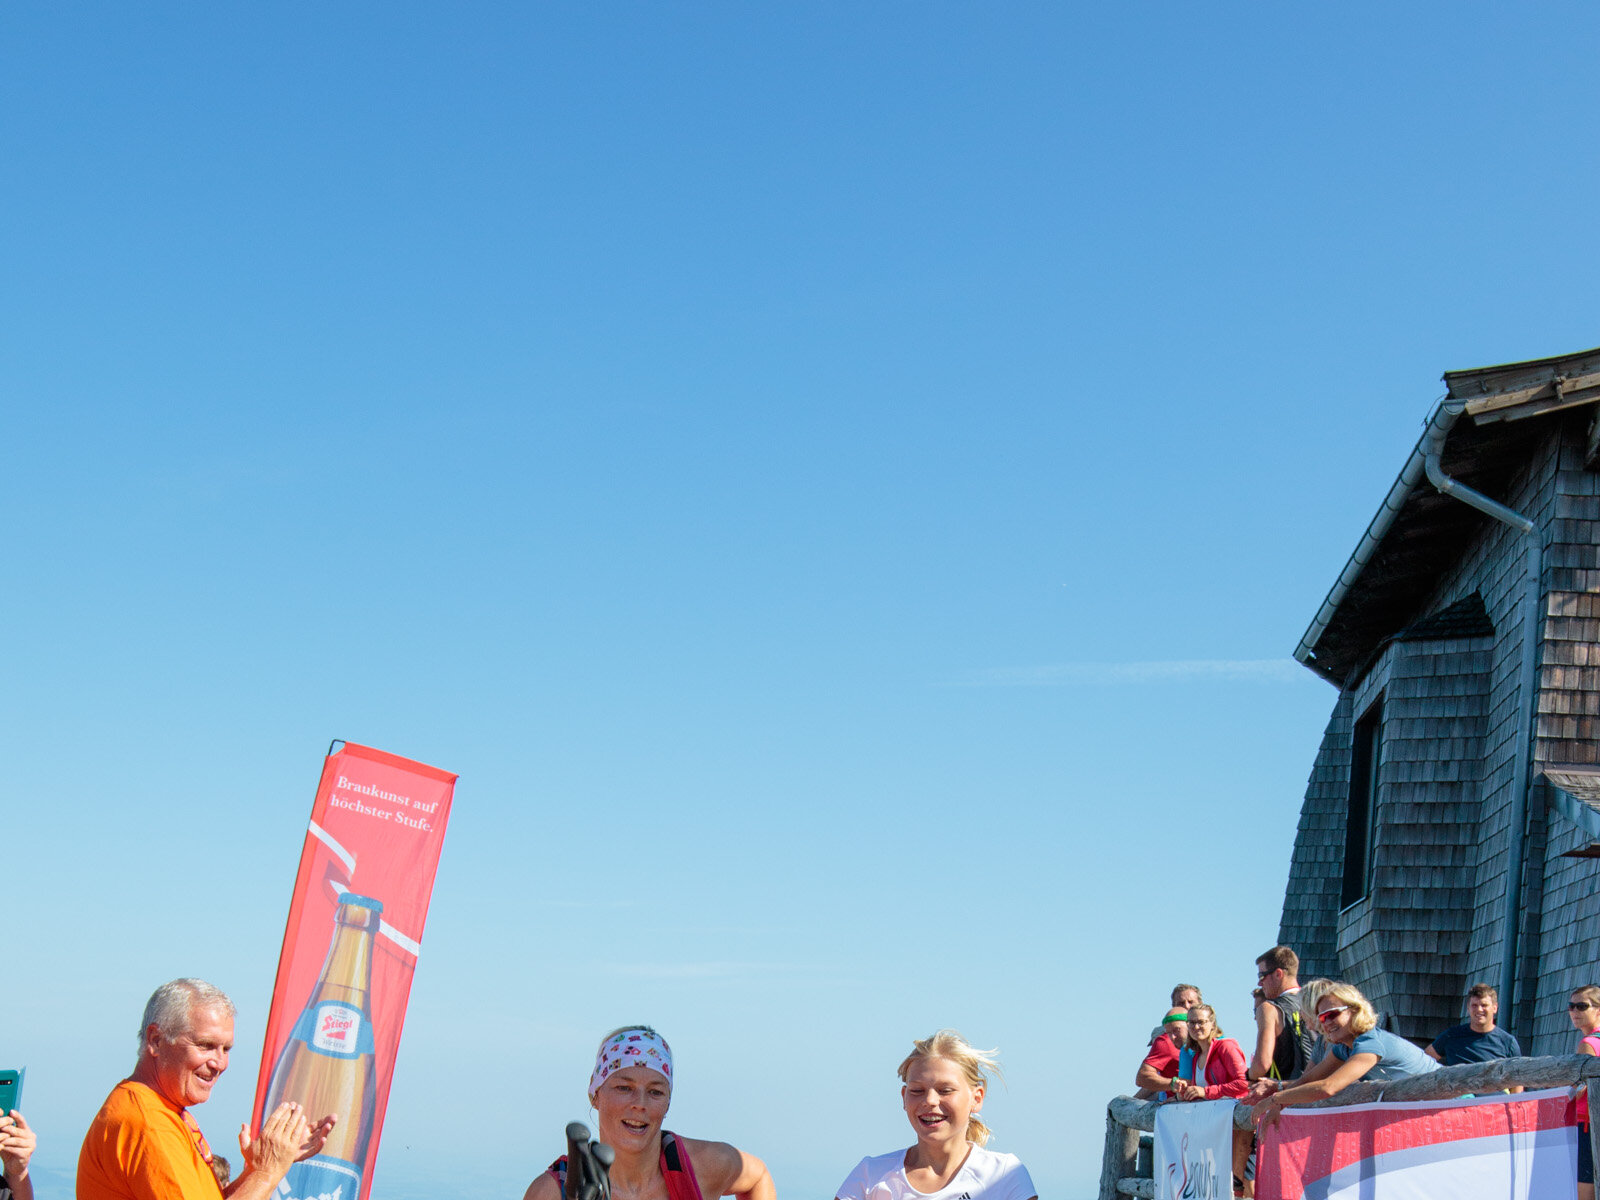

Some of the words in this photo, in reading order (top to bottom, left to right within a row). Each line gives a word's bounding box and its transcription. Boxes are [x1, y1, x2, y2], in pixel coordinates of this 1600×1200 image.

[331, 794, 392, 820] höchster
[395, 811, 433, 833] Stufe.
[337, 775, 410, 806] Braukunst
[413, 800, 439, 814] auf
[322, 1014, 353, 1032] Stiegl
